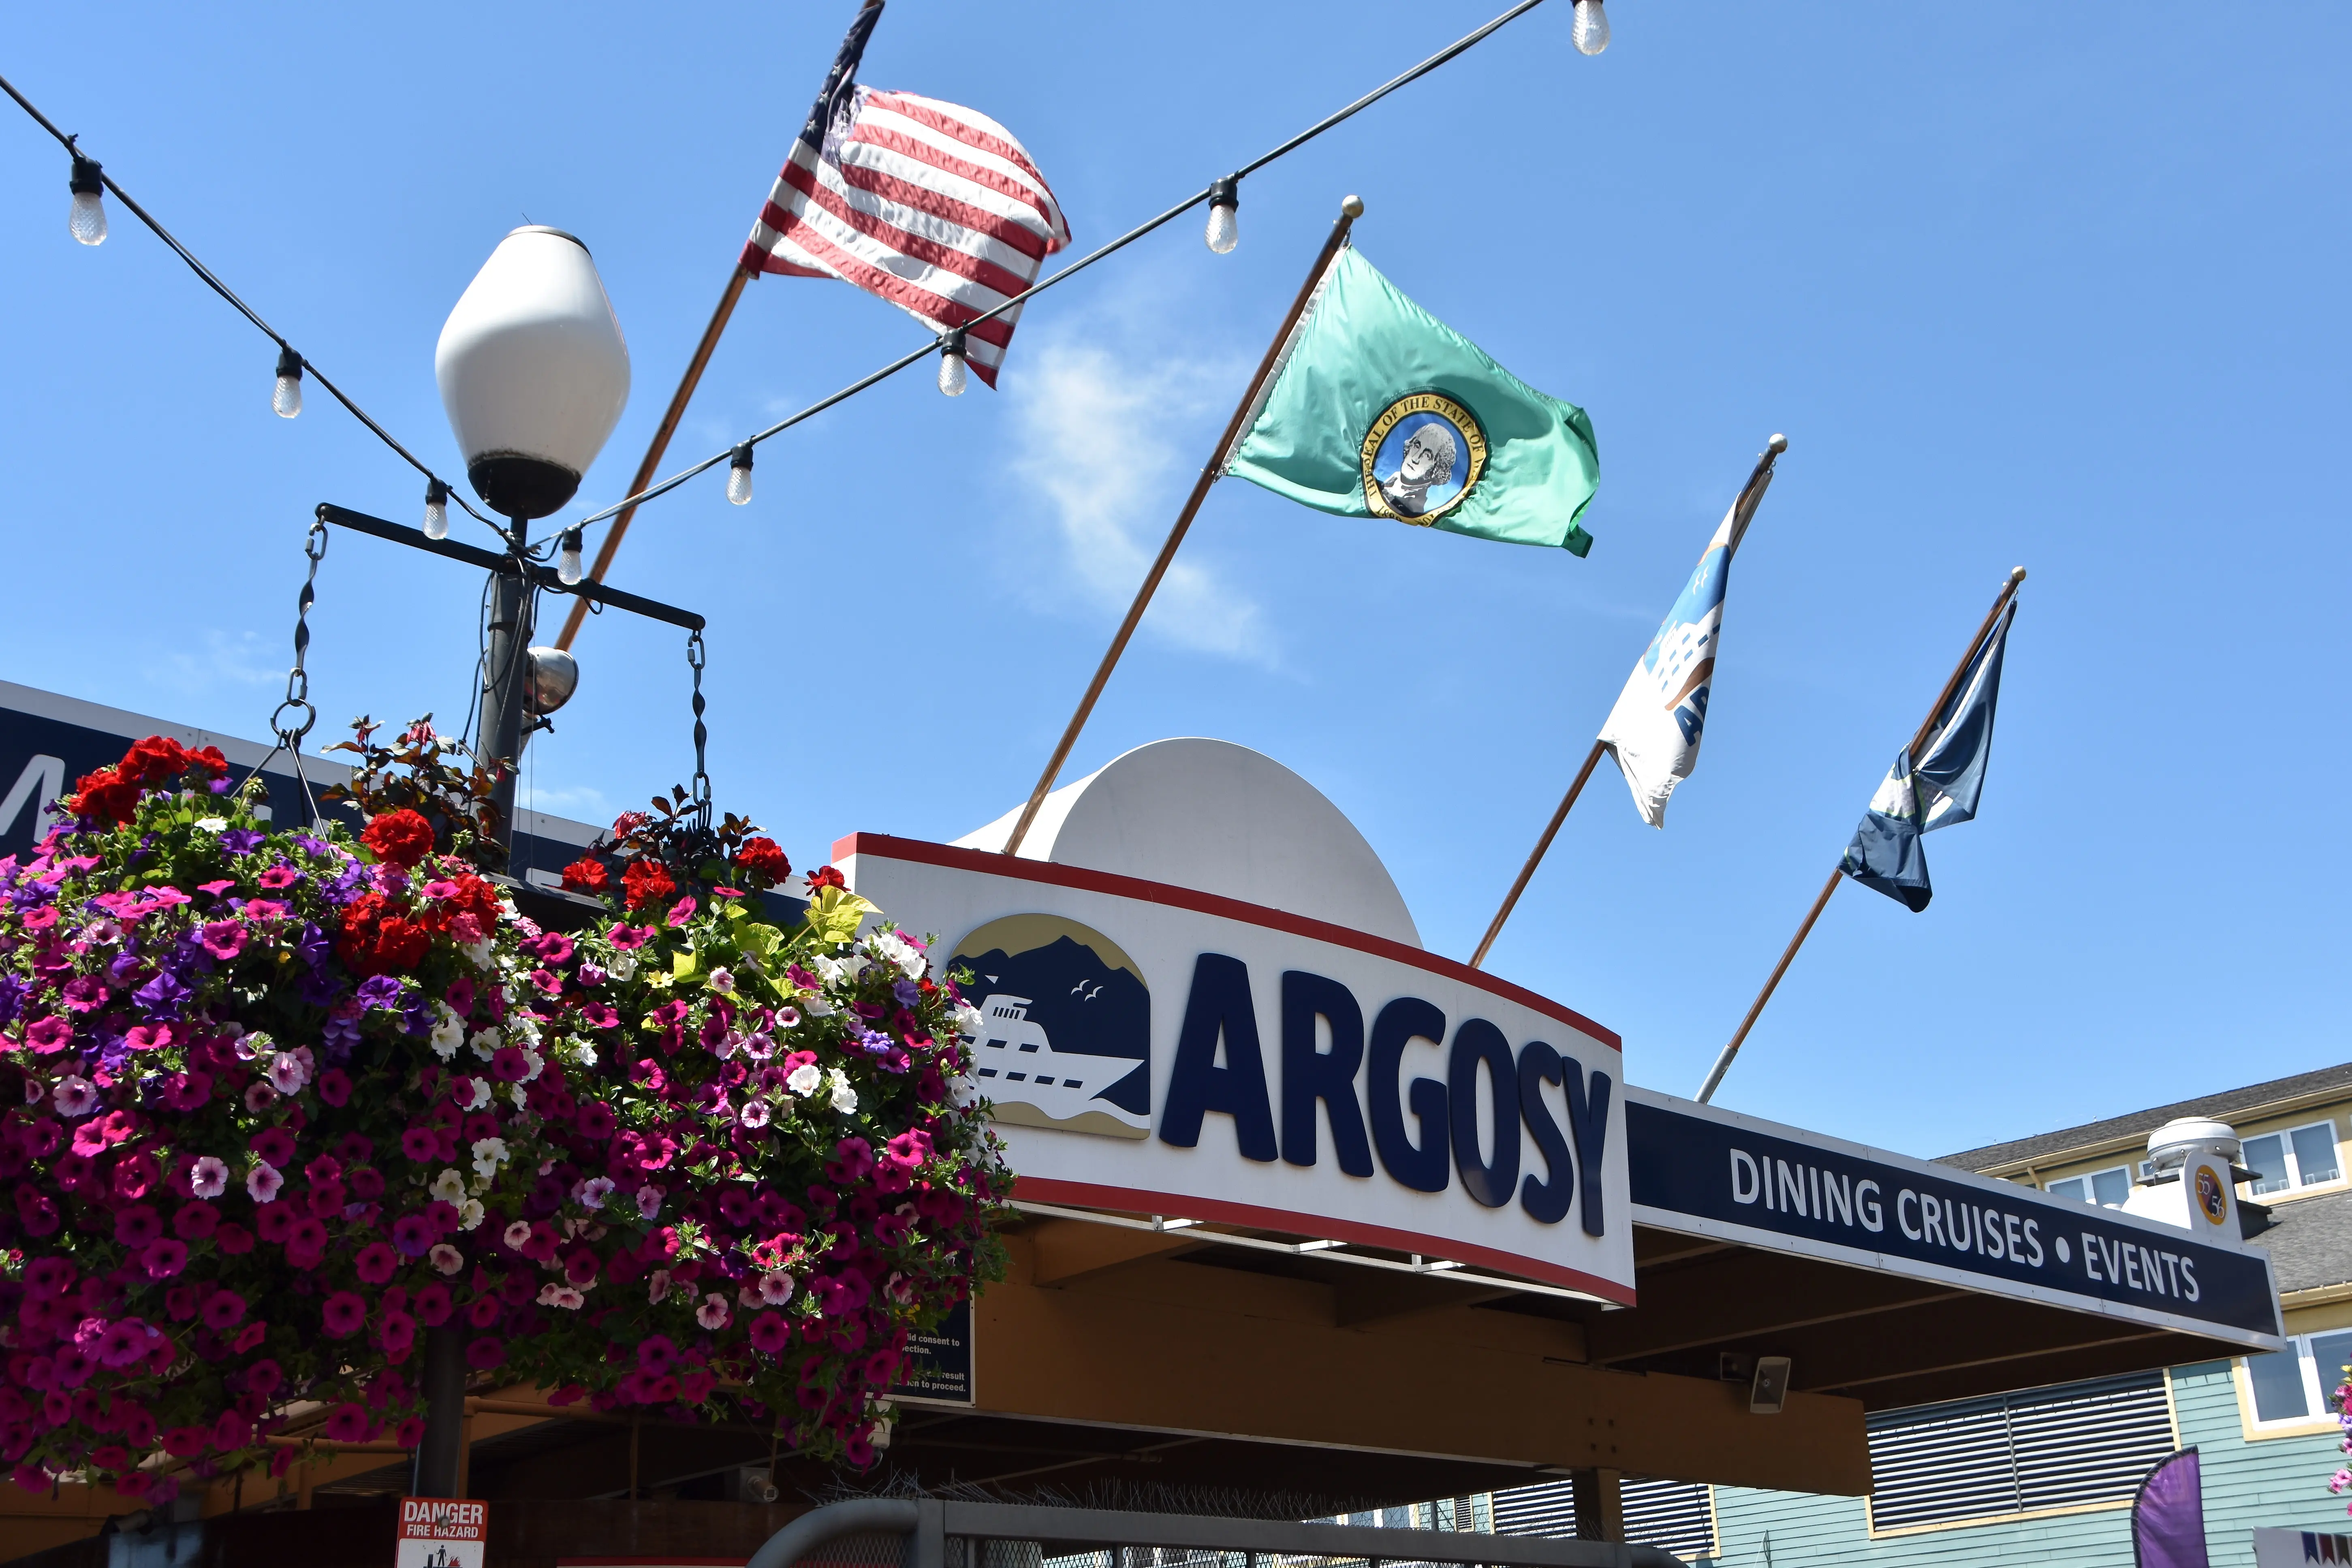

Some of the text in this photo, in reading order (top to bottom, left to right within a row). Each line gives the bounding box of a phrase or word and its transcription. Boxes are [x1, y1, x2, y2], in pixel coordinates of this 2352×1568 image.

[1382, 406, 1399, 426] OF
[1401, 396, 1429, 412] THE
[1433, 398, 1474, 433] STATE
[1470, 433, 1484, 453] OF
[1159, 952, 1612, 1237] ARGOSY
[2198, 1172, 2210, 1195] 55
[2212, 1195, 2224, 1218] 56
[1730, 1148, 2200, 1303] DINING CRUISES EVENTS
[919, 1336, 949, 1346] consent
[952, 1338, 960, 1346] to
[932, 1382, 966, 1392] proceed.
[404, 1501, 483, 1524] DANGER
[406, 1524, 479, 1538] FIRE HAZARD
